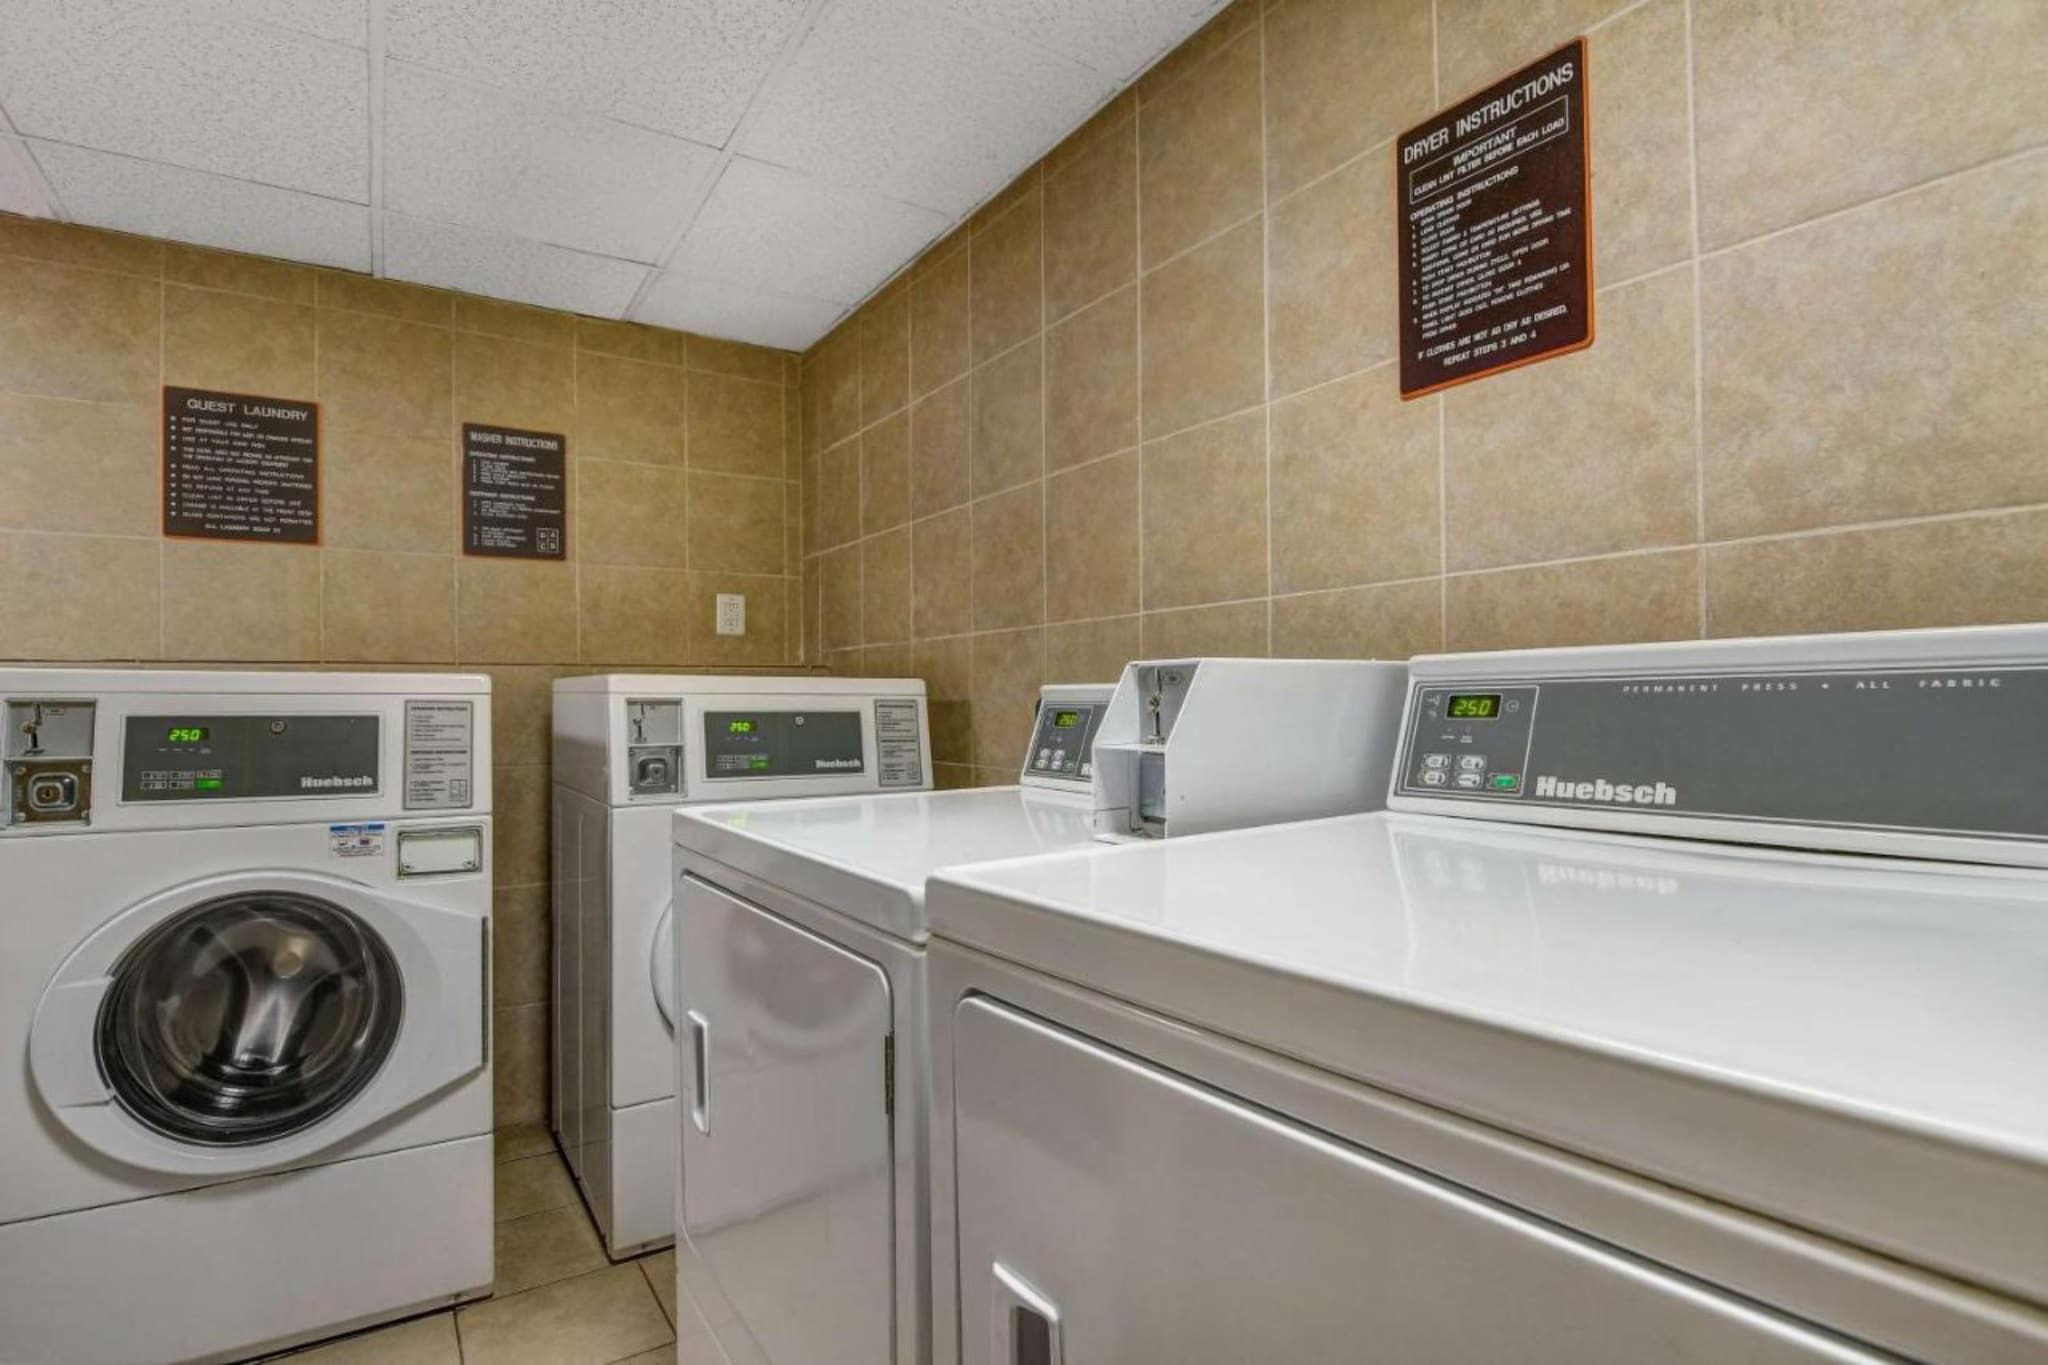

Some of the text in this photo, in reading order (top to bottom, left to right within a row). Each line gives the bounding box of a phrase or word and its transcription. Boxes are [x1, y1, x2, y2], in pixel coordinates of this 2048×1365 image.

[1404, 62, 1574, 165] DRYER INSTRUCTIONS
[1414, 117, 1565, 196] CLEAN LINT FILTER BEFORE EACH LOAD
[1453, 126, 1517, 166] IMPORTANT
[1410, 165, 1520, 221] OPERATING INSTRUCTIONS
[1426, 339, 1455, 358] CLOTHES
[1457, 335, 1471, 347] ARE
[1472, 330, 1488, 342] NOT
[1491, 326, 1501, 336] AS
[1503, 320, 1518, 332] DRY
[1520, 315, 1532, 327] AS
[1443, 350, 1471, 366] REPEAT
[1473, 342, 1498, 358] STEPS
[1509, 333, 1528, 346] AND
[186, 398, 309, 421] GUEST LAUNDRY
[470, 431, 559, 451] WASHER INSTRUCTIONS
[1623, 678, 2001, 694] PERMANENT PRESS ALL FABRIC
[1453, 699, 1492, 716] 250
[168, 728, 202, 742] 250
[815, 758, 862, 769] Huebsch
[301, 775, 374, 789] Huebsch
[1535, 775, 1677, 805] Huebsch
